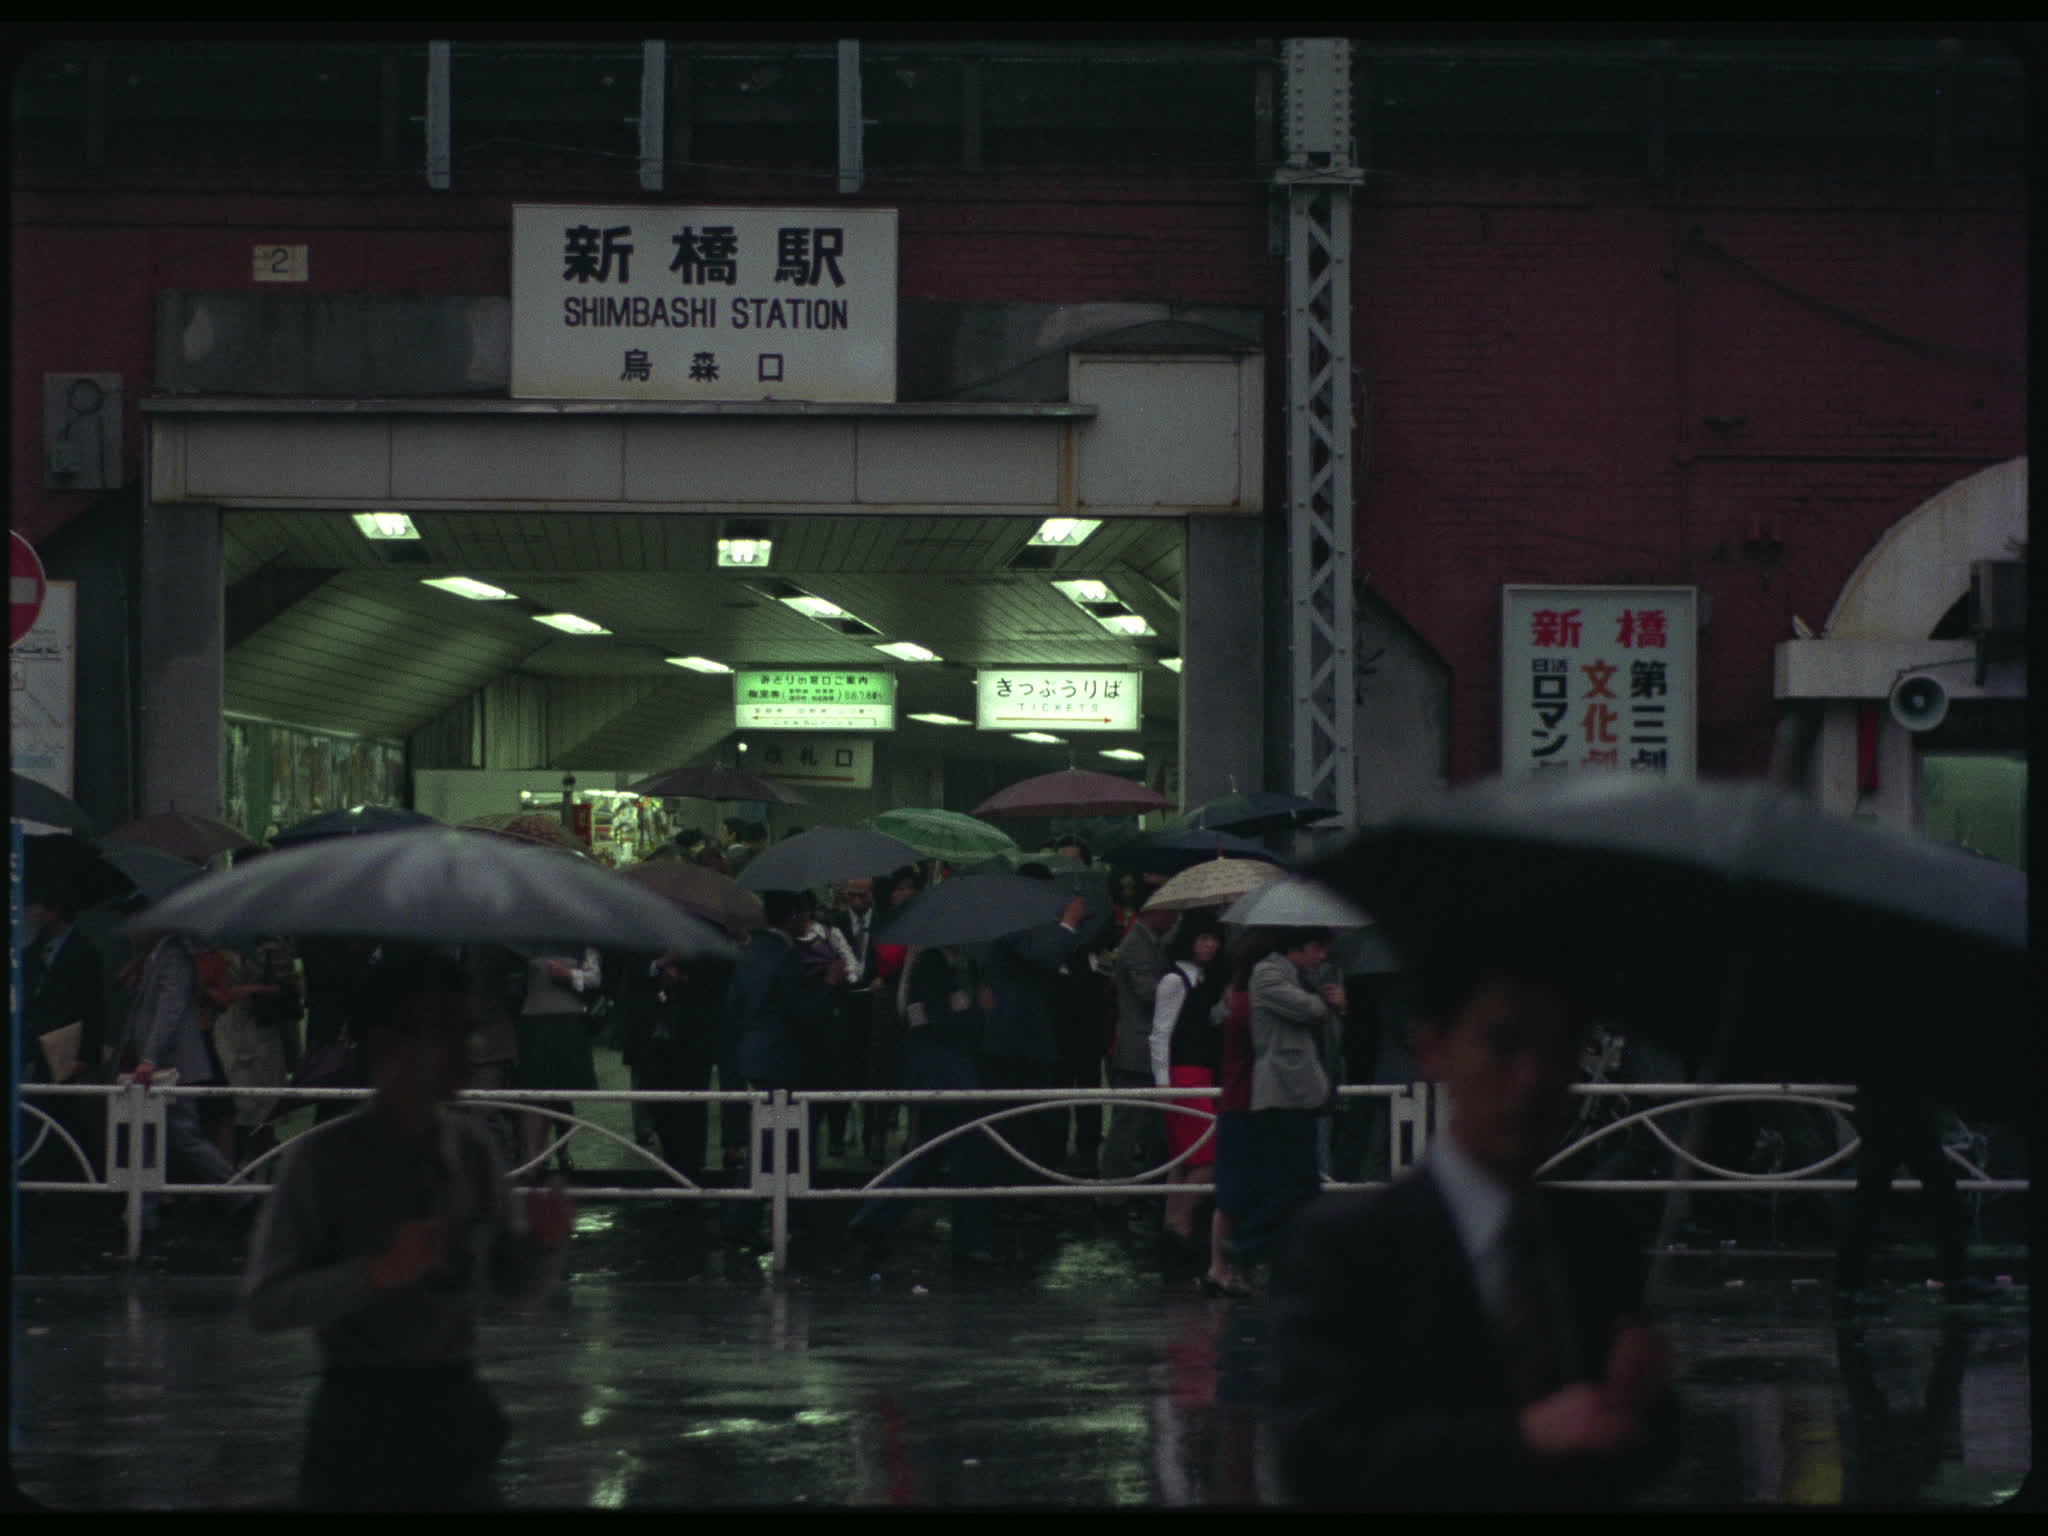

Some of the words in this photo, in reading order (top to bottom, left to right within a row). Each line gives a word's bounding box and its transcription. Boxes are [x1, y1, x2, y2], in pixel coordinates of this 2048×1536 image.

[562, 224, 846, 288] 新橋駅
[563, 296, 717, 329] SHIMBASHI
[730, 297, 848, 330] STATION
[1531, 608, 1667, 649] 新橋
[1017, 703, 1098, 713] TICKETS
